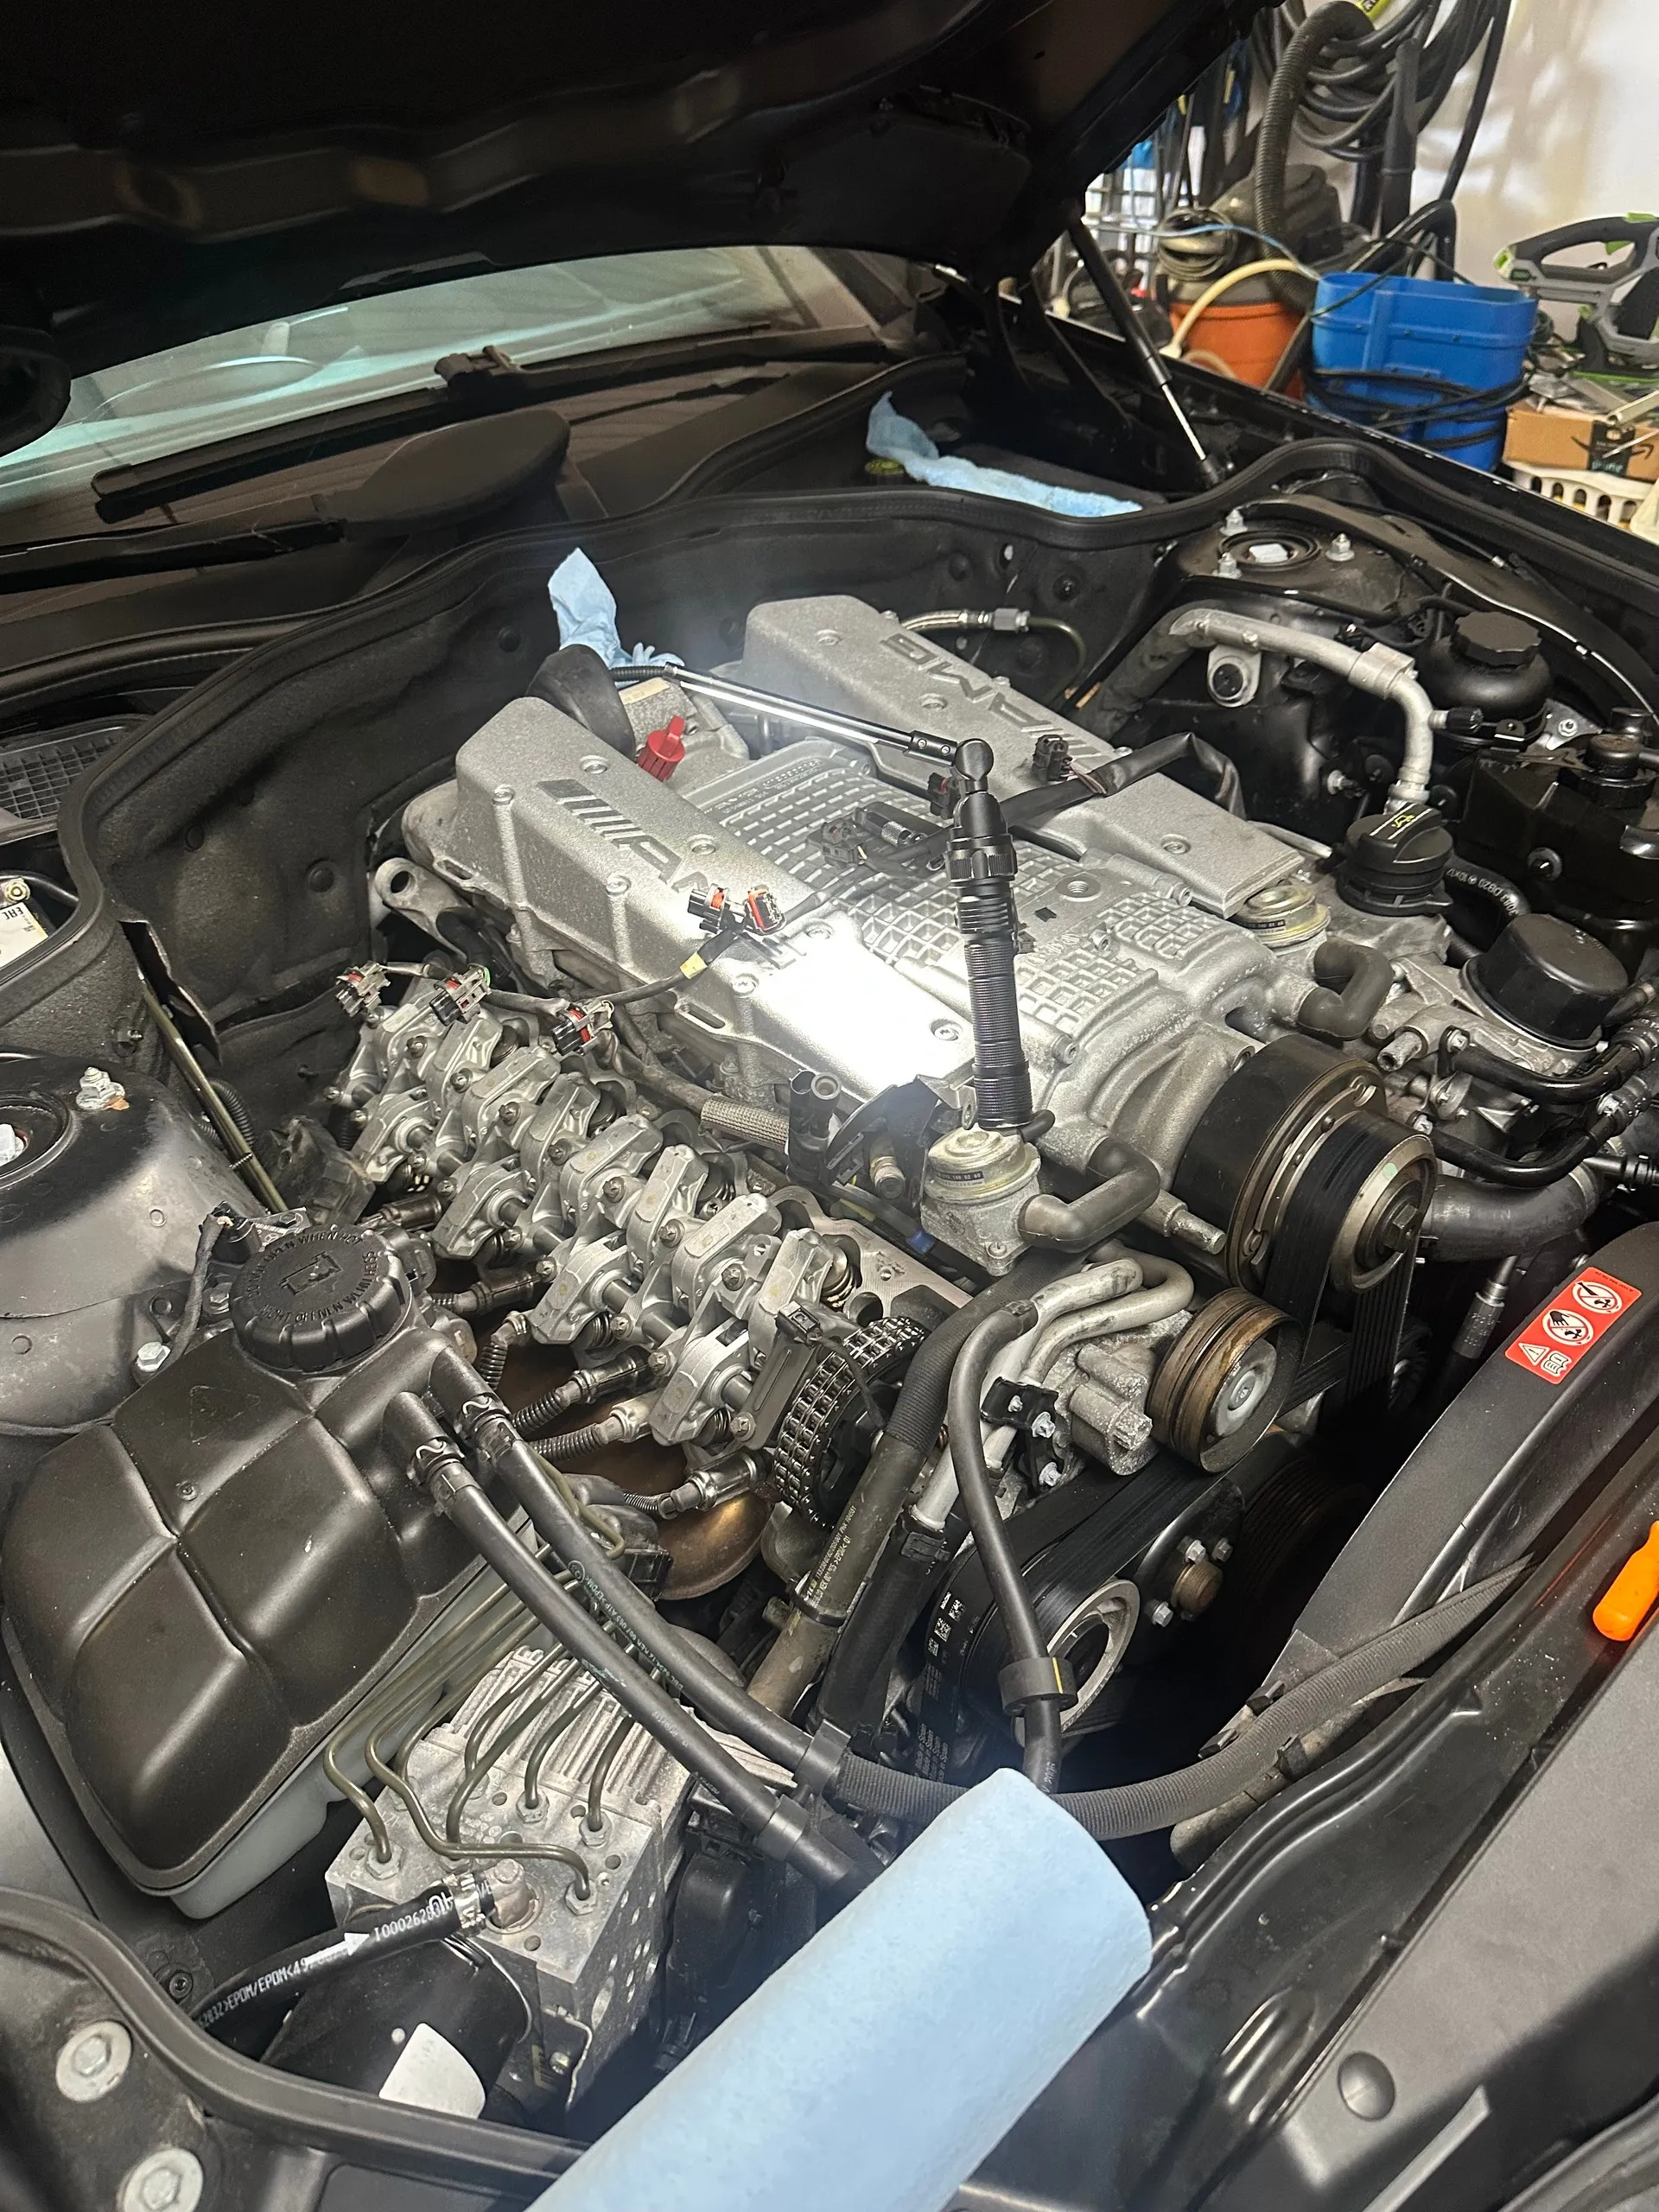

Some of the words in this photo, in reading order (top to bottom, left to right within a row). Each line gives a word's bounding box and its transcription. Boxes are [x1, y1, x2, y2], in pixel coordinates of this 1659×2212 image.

[880, 633, 1054, 734] AMG
[1478, 878, 1504, 897] DB20
[299, 1231, 339, 1244] WHEN
[340, 1233, 364, 1246] HOT
[362, 1250, 378, 1276] HEISS
